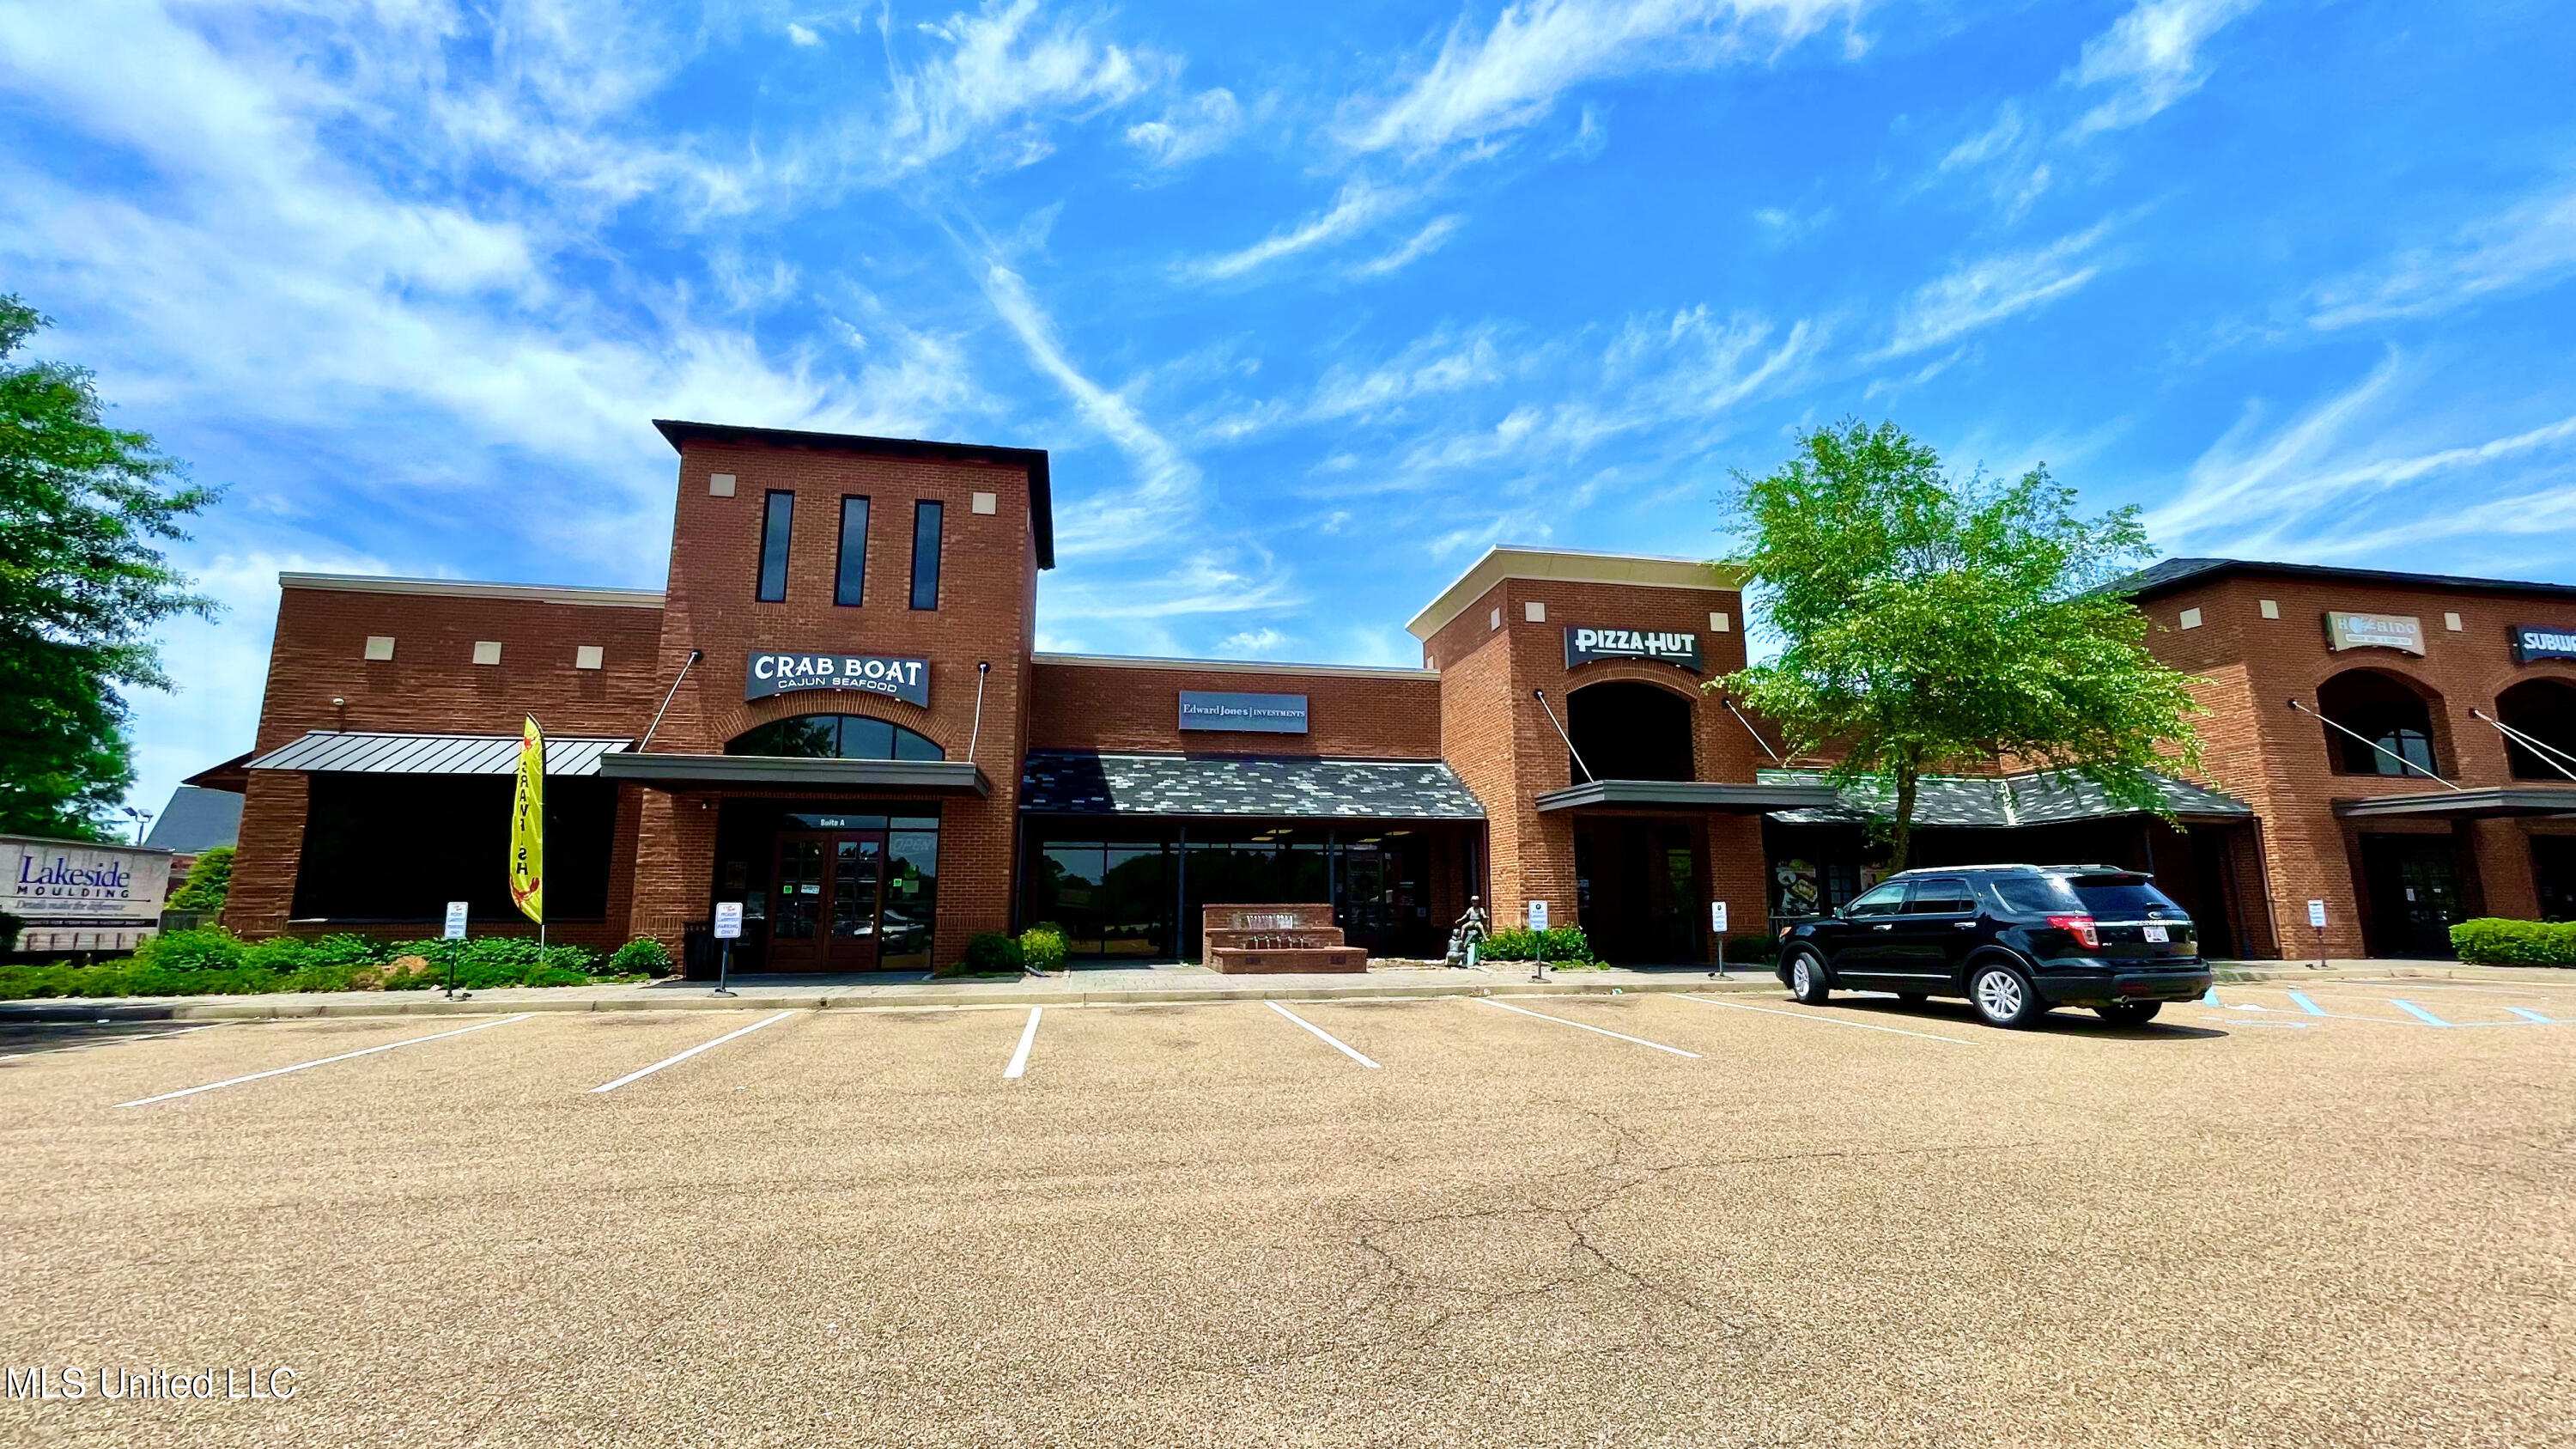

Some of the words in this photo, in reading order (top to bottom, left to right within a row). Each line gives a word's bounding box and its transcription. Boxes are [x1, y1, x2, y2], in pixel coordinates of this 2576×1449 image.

[1575, 629, 1643, 652] PIZZA
[1644, 632, 1695, 655] HUT
[755, 655, 835, 679] CRAB
[845, 659, 922, 685] BOAT
[778, 678, 827, 689] CAJUN
[832, 678, 897, 693] SEAFOOD
[1183, 703, 1220, 715] Edward
[1220, 705, 1249, 716] Jones
[1253, 709, 1305, 718] INVESTMENTS
[20, 855, 131, 887] Lakeside
[16, 886, 130, 898] MOULDING
